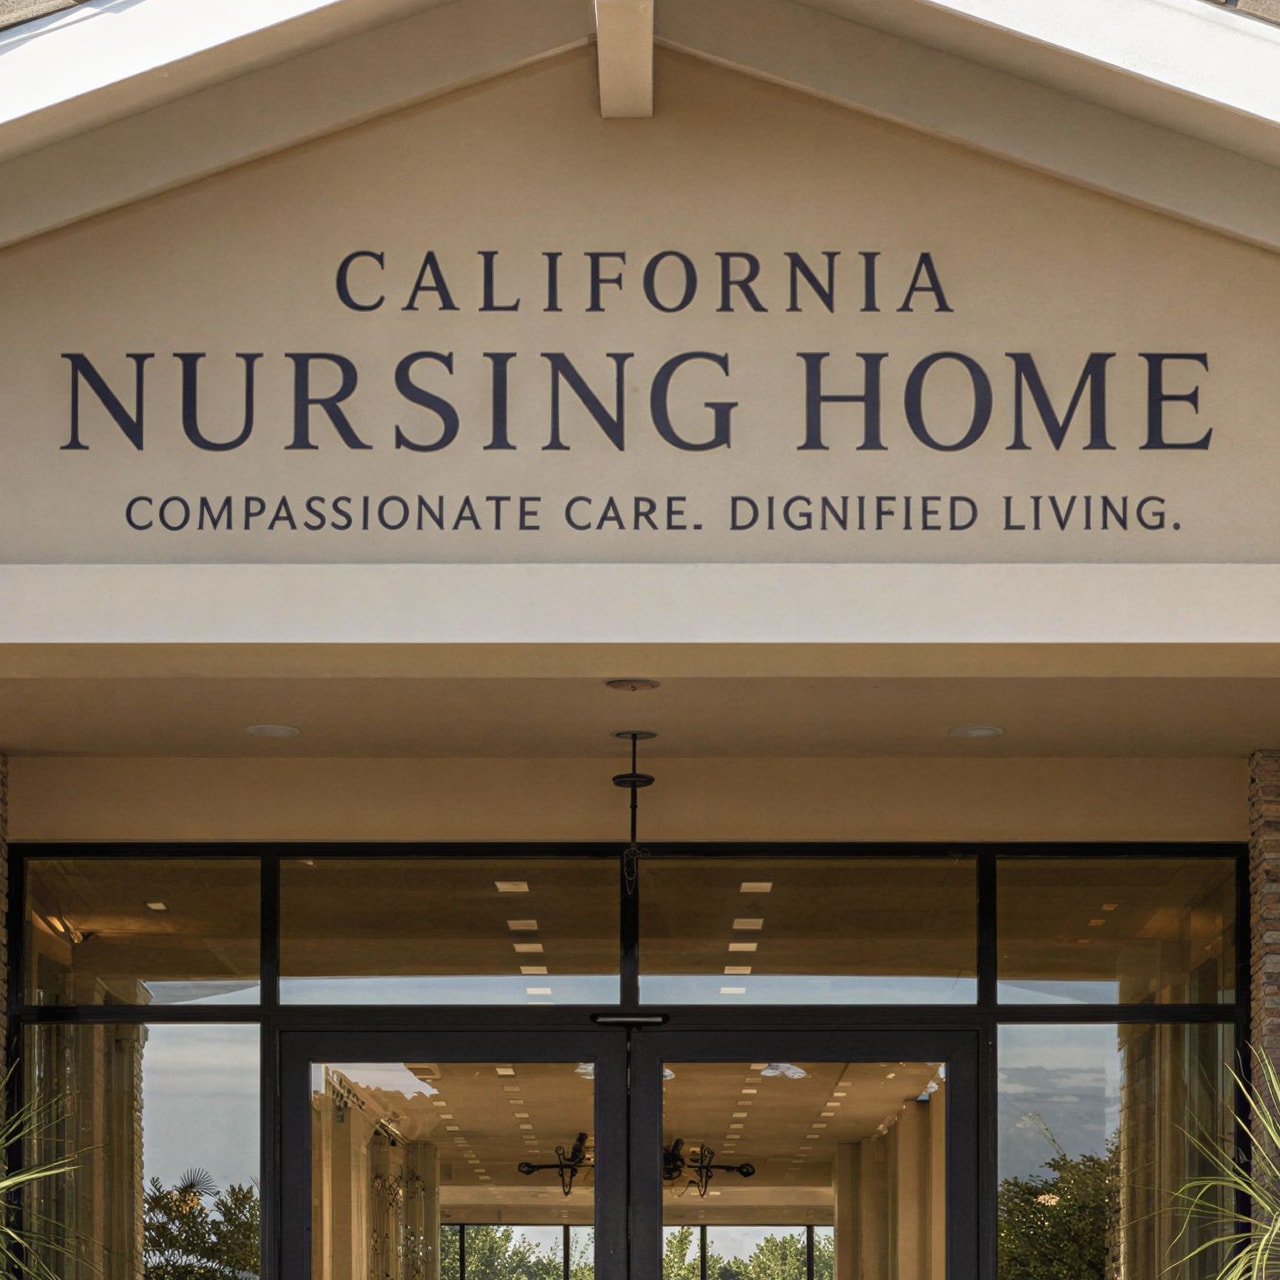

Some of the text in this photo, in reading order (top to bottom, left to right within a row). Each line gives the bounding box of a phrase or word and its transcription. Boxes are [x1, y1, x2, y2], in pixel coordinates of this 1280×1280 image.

[334, 249, 956, 315] CALIFORNIA
[59, 349, 1214, 454] NURSING HOME
[124, 494, 1182, 532] COMPASSIONATE CARE. DIGNIFIED LIVING.
